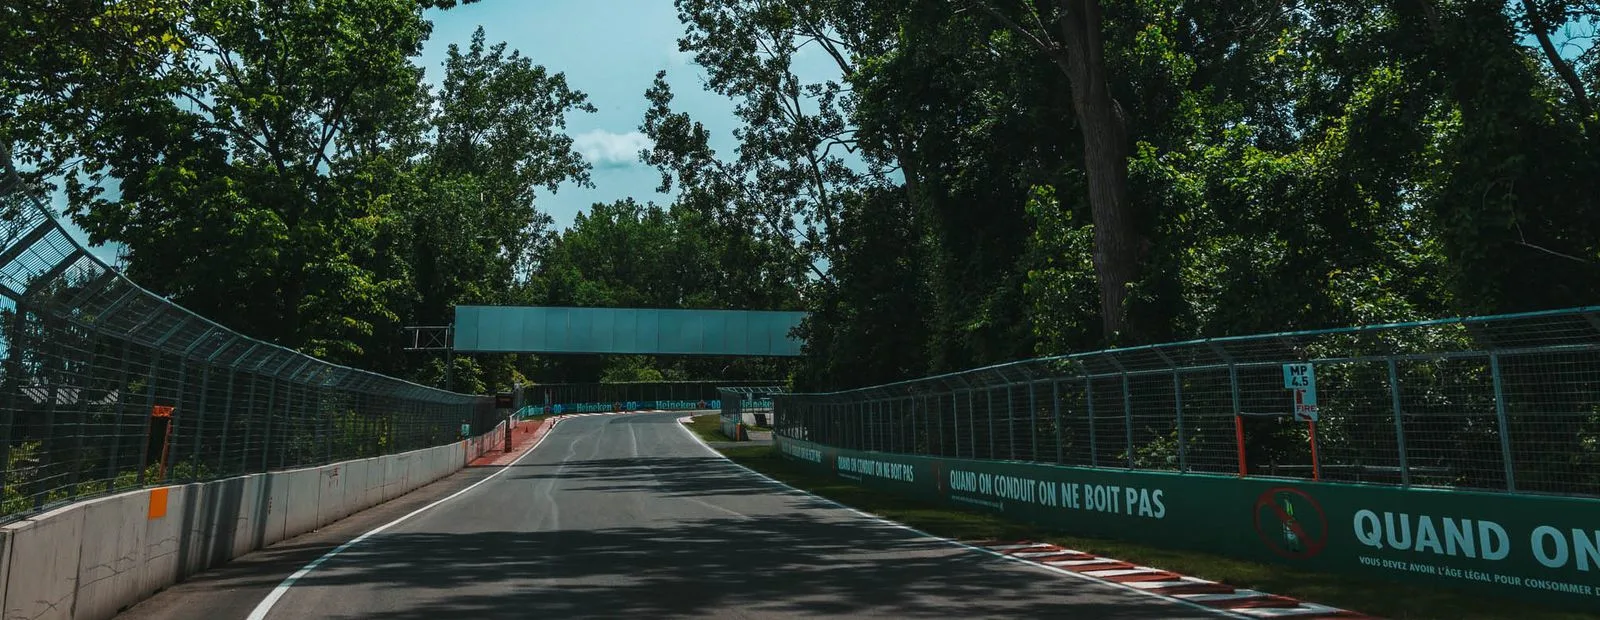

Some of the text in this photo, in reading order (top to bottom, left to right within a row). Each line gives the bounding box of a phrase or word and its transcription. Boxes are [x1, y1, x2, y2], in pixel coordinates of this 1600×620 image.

[1290, 366, 1307, 376] MP
[1292, 376, 1308, 386] 4.5
[576, 402, 612, 413] Heineken
[655, 400, 696, 410] Heineken
[850, 458, 857, 472] ON
[875, 461, 883, 477] ON
[883, 462, 890, 479] NE
[890, 463, 902, 480] BOIT
[902, 464, 914, 482] PAS
[950, 469, 977, 493] QUAND
[978, 472, 992, 496] ON
[994, 474, 1036, 504] CONDUIT
[1038, 480, 1057, 506] ON
[1060, 482, 1081, 509] NE
[1084, 483, 1121, 514] BOIT
[1125, 487, 1167, 519] PAS
[1353, 508, 1600, 572] QUAND ON
[1358, 555, 1381, 567] VOUS
[1382, 558, 1407, 570] DEVEZ
[1409, 562, 1436, 575] AVOIR
[1438, 564, 1463, 579] L'ÂGE
[1464, 568, 1491, 583] LÉGAL
[1494, 573, 1521, 586] POUR
[1524, 578, 1593, 596] CONSOMMER
